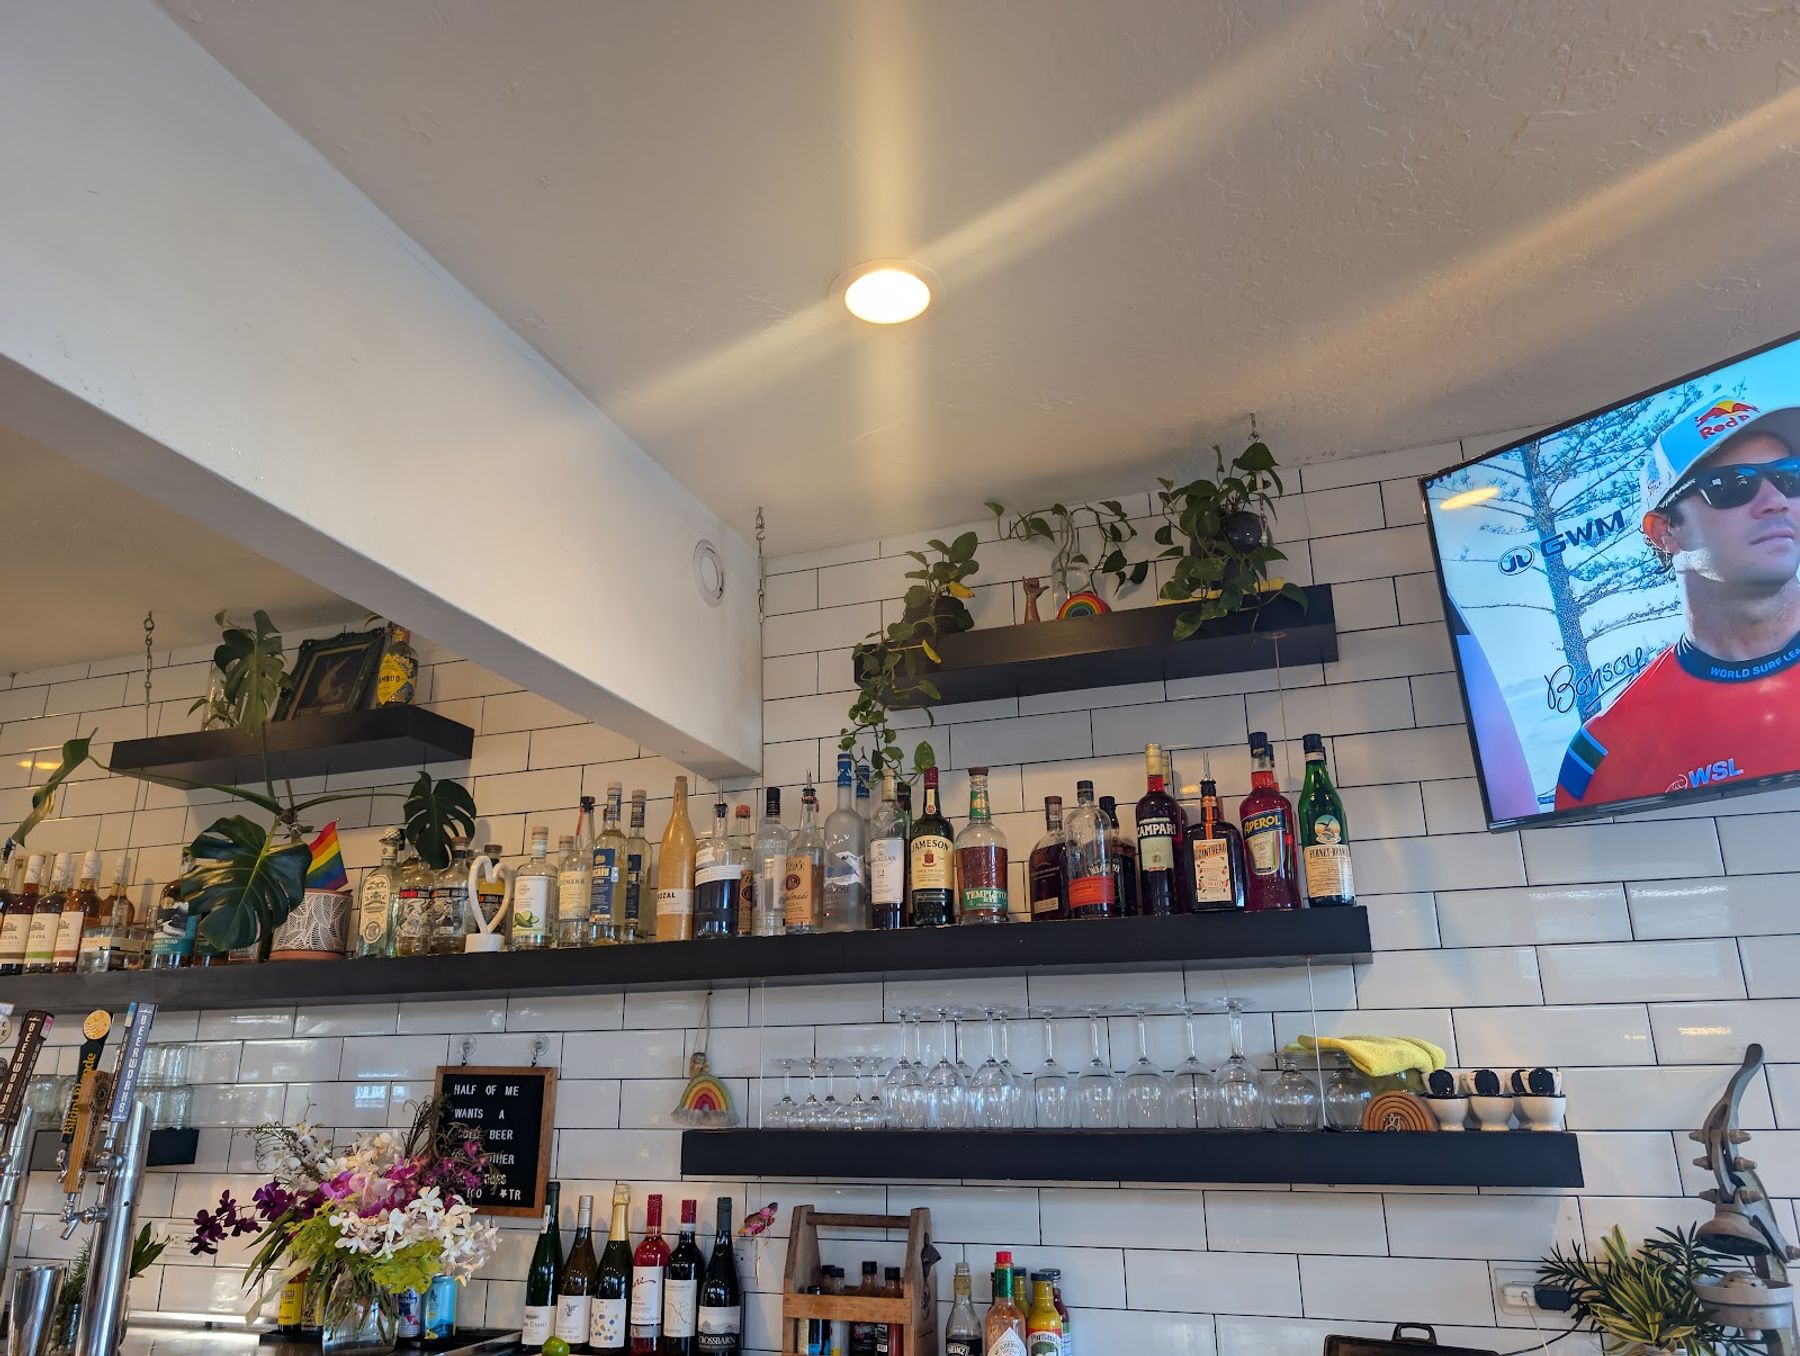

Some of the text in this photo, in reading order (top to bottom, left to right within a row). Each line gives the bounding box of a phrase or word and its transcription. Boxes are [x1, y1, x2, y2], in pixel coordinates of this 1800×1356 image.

[1541, 510, 1625, 557] GWM
[1710, 666, 1750, 678] WORLD
[1753, 658, 1782, 675] SURF
[1544, 647, 1646, 713] Bonsoy
[1688, 758, 1744, 787] WSL
[1137, 823, 1177, 838] CAMPARI
[1244, 814, 1281, 834] APEROL
[912, 839, 949, 852] JAMESON
[118, 1014, 148, 1112] BEERWORKS
[453, 1083, 520, 1097] HALF OF ME
[454, 1107, 505, 1120] WANTS A
[489, 1129, 514, 1140] BEER
